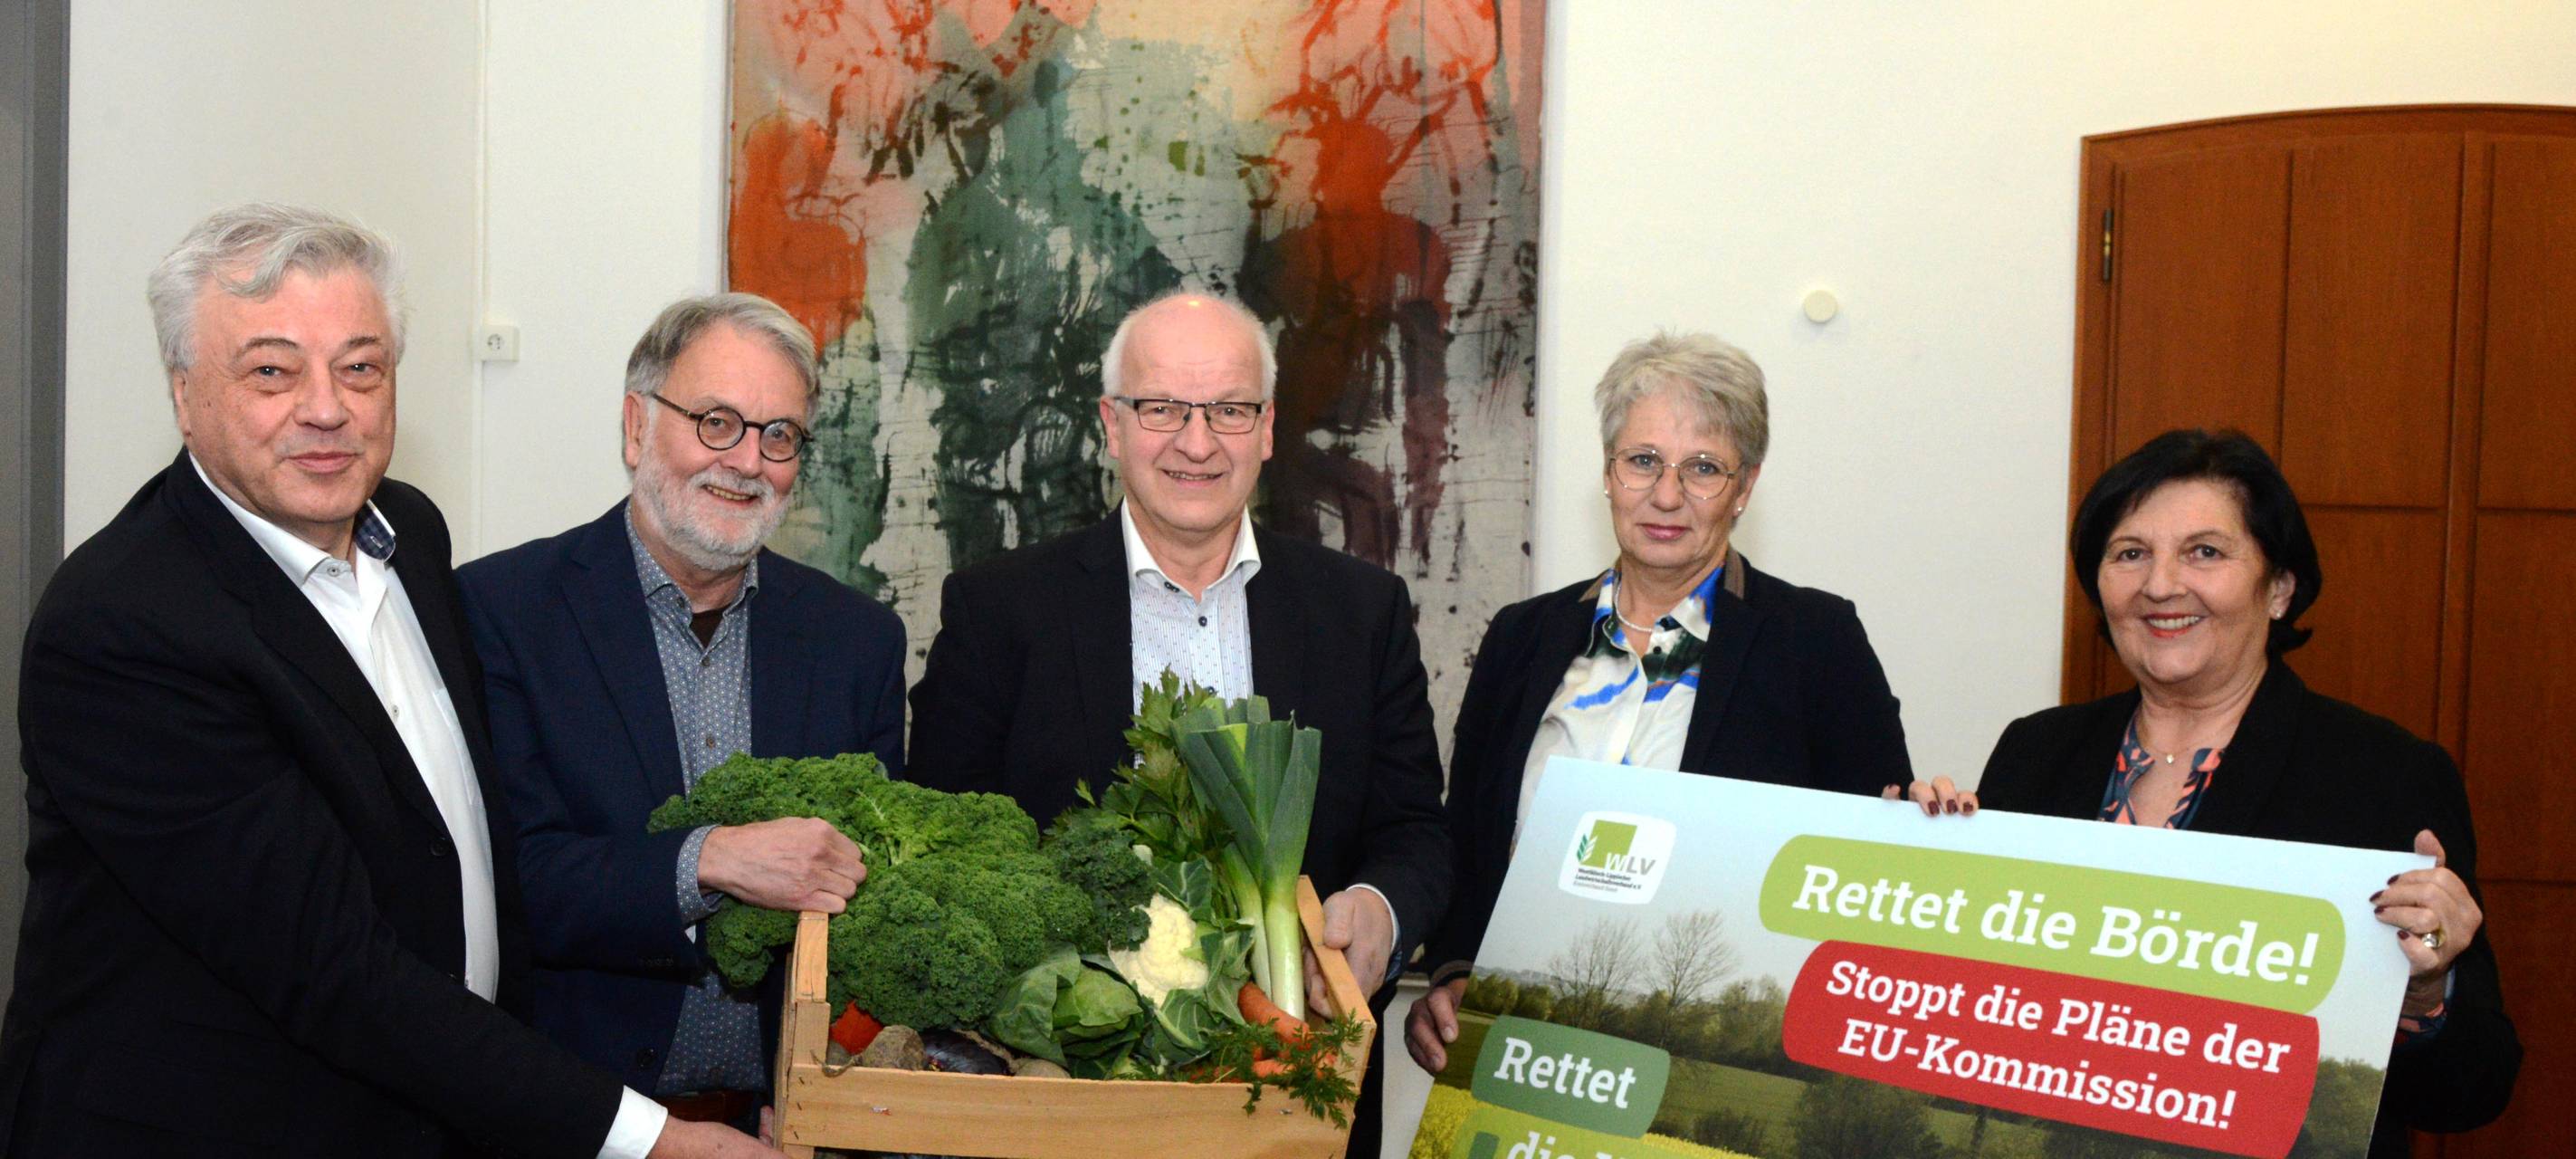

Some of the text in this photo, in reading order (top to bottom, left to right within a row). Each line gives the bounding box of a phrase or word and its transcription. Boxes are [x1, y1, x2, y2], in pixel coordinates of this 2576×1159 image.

[1605, 851, 1656, 876] WLV
[1792, 864, 2320, 987] Rettet die Börde!
[1493, 1037, 1637, 1109] Rettet
[1826, 960, 2292, 1074] Stoppt die Pläne der
[1837, 1018, 2237, 1130] EU-Kommission!
